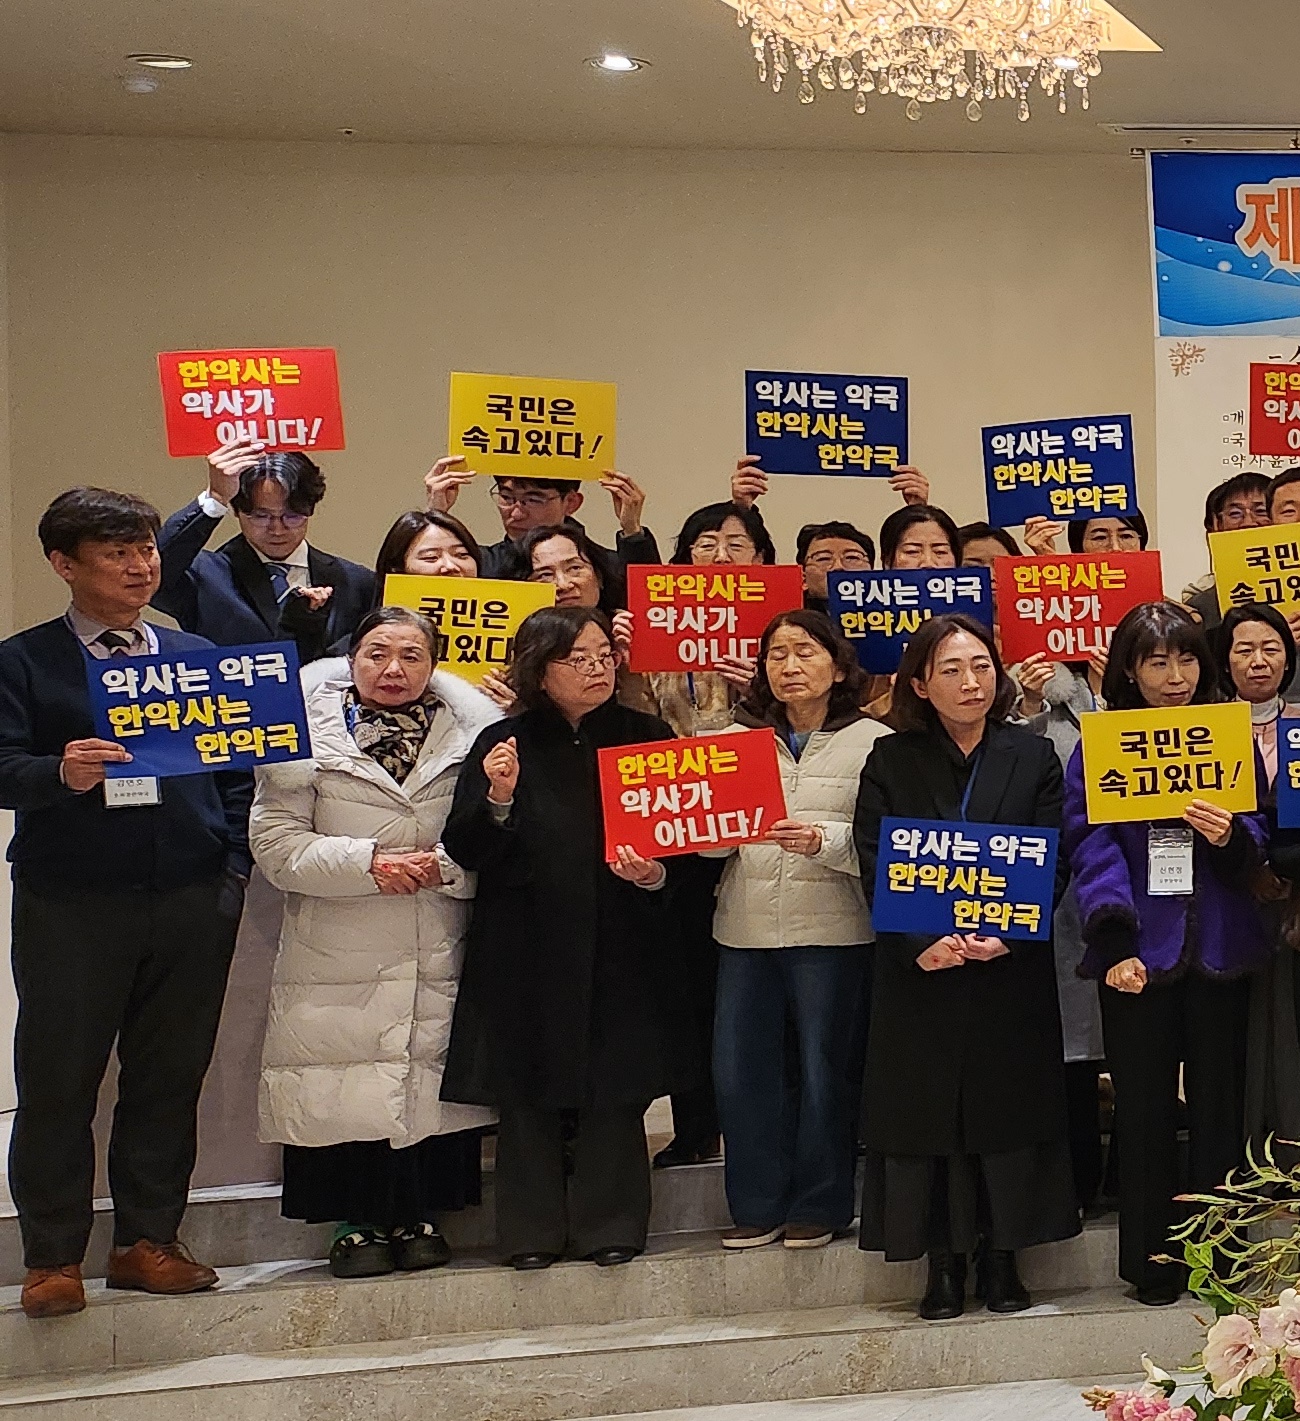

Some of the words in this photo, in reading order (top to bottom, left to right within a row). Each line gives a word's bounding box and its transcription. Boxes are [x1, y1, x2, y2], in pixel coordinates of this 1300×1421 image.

[179, 358, 300, 387] 한약사는
[182, 389, 275, 418] 약사가
[486, 395, 576, 425] 국민은
[756, 381, 837, 408] 약사는
[845, 385, 898, 411] 약국
[216, 418, 321, 447] 아니다!
[757, 411, 865, 439] 한약사는
[462, 426, 603, 459] 속고있다!
[991, 430, 1065, 459] 약사는
[1072, 424, 1123, 451] 약국
[818, 444, 900, 471] 한약국
[994, 458, 1093, 490] 한약사는
[1050, 485, 1127, 515] 한약국
[647, 574, 765, 601] 한약사는
[838, 579, 919, 606] 약사는
[927, 577, 982, 603] 약국
[1014, 562, 1126, 593] 한약사는
[420, 598, 509, 628] 국민은
[647, 606, 738, 633] 약사가
[1016, 595, 1101, 624] 약사가
[102, 662, 210, 698] 약사는
[219, 653, 287, 686] 약국
[108, 695, 252, 739] 한약사는
[195, 724, 298, 763] 한약국
[1120, 727, 1213, 759] 국민은
[618, 745, 738, 787] 한약사는
[1099, 761, 1242, 798] 속고있다!
[621, 781, 712, 817] 약사가
[655, 807, 765, 849] 아니다!
[892, 829, 980, 861] 약사는
[989, 836, 1047, 866] 약국
[889, 863, 1006, 896] 한약사는
[954, 900, 1040, 932] 한약국
